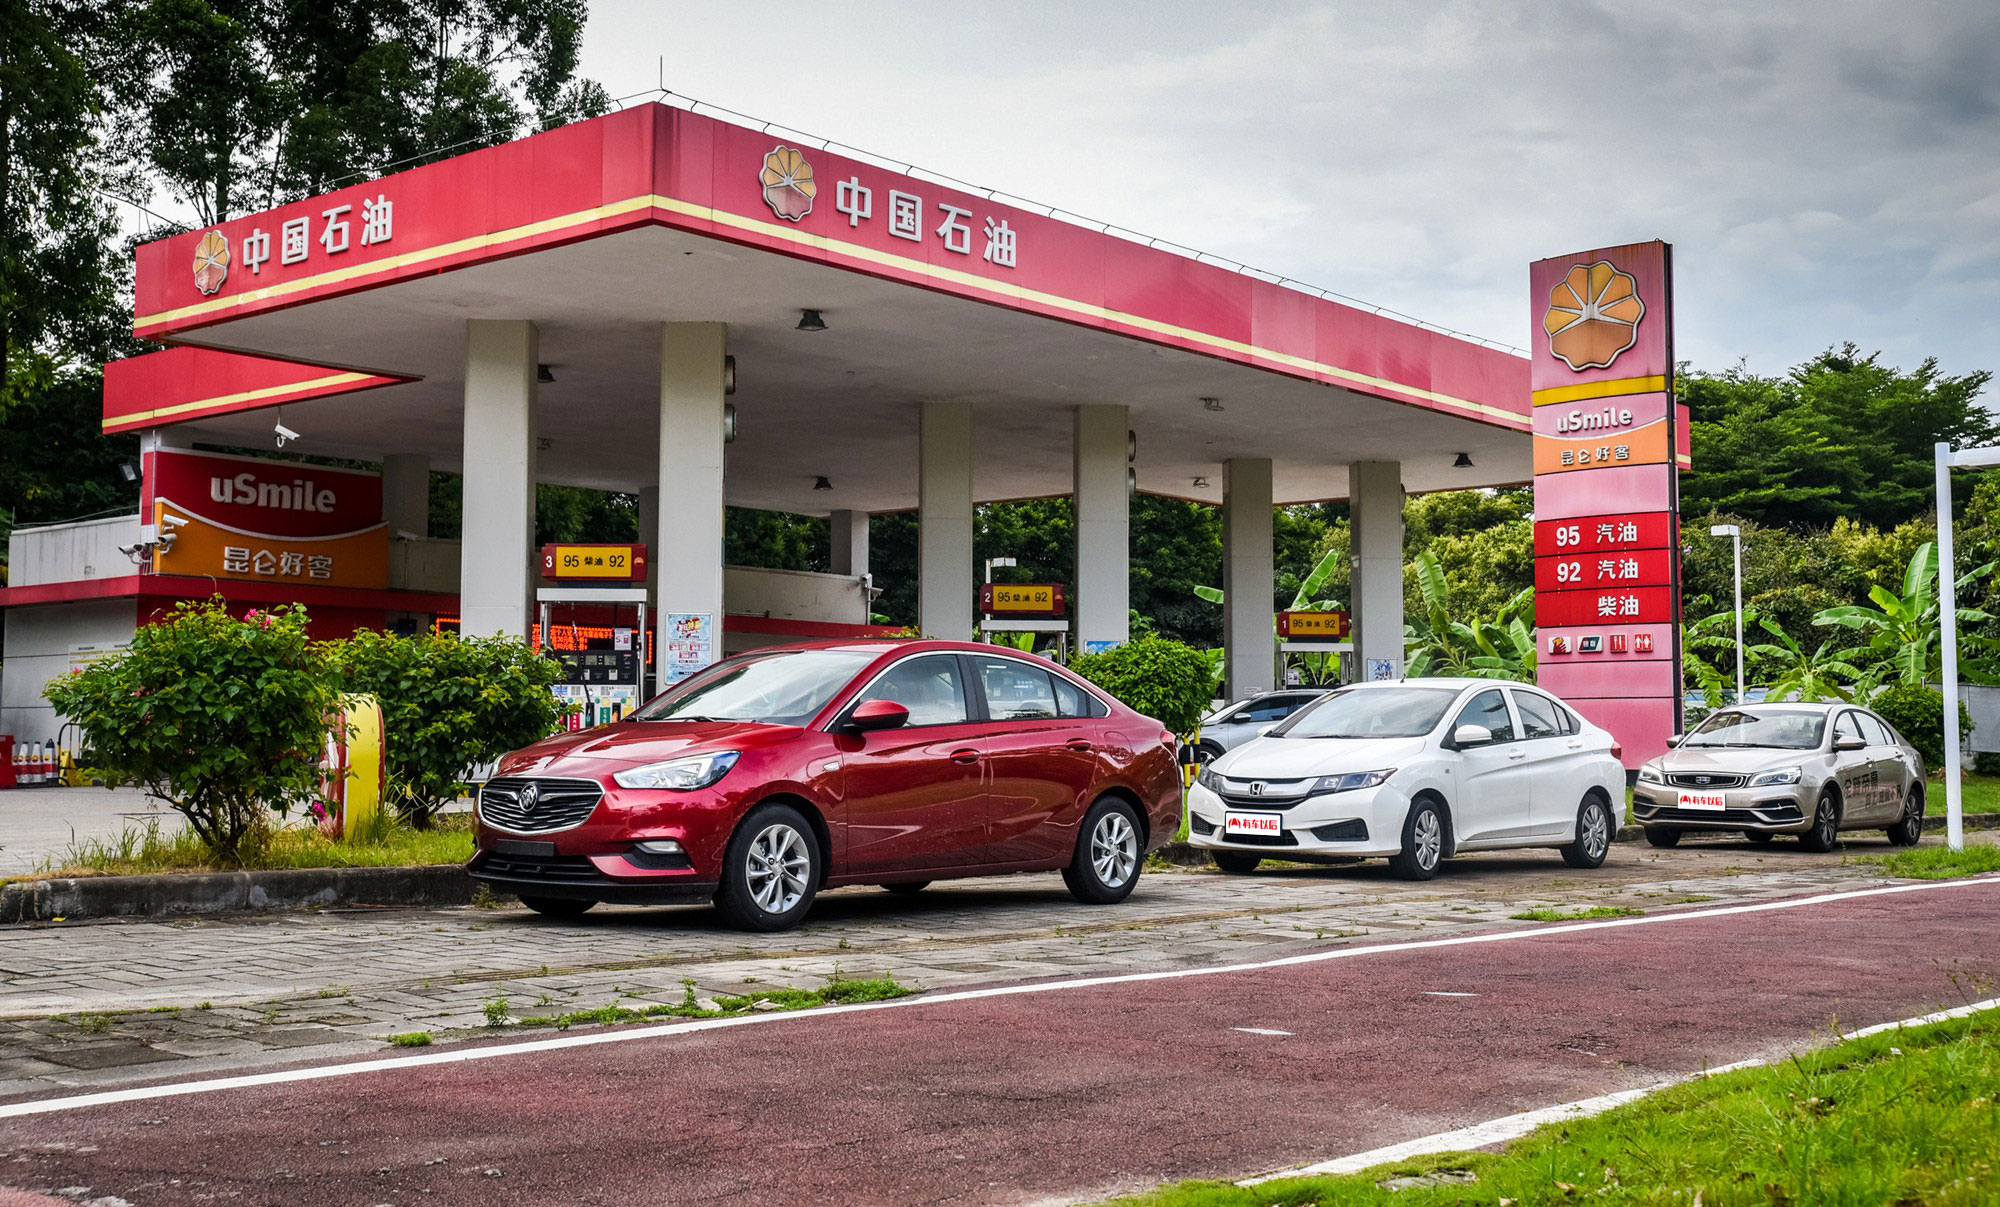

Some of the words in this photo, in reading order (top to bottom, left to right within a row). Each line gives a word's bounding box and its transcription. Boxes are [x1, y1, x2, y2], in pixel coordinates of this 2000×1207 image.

[836, 176, 1017, 268] 中国石油
[242, 194, 393, 274] 中国石油
[1556, 407, 1633, 433] uSmile
[1561, 445, 1630, 466] 昆仑好客
[210, 473, 337, 513] uSmile
[1556, 526, 1581, 547] 95
[1596, 522, 1638, 544] 汽油
[223, 546, 333, 579] 昆仑好客
[545, 555, 553, 568] 3
[563, 555, 580, 568] 95
[609, 555, 625, 568] 92
[1556, 562, 1582, 583] 92
[1597, 558, 1639, 580] 汽油
[984, 592, 991, 603] 2
[997, 591, 1011, 603] 95
[1034, 591, 1048, 603] 92
[1597, 595, 1639, 617] 柴油
[1282, 620, 1287, 629] 1
[1292, 619, 1304, 628] 95
[1324, 619, 1336, 629] 92
[1242, 818, 1278, 831] 有车以后
